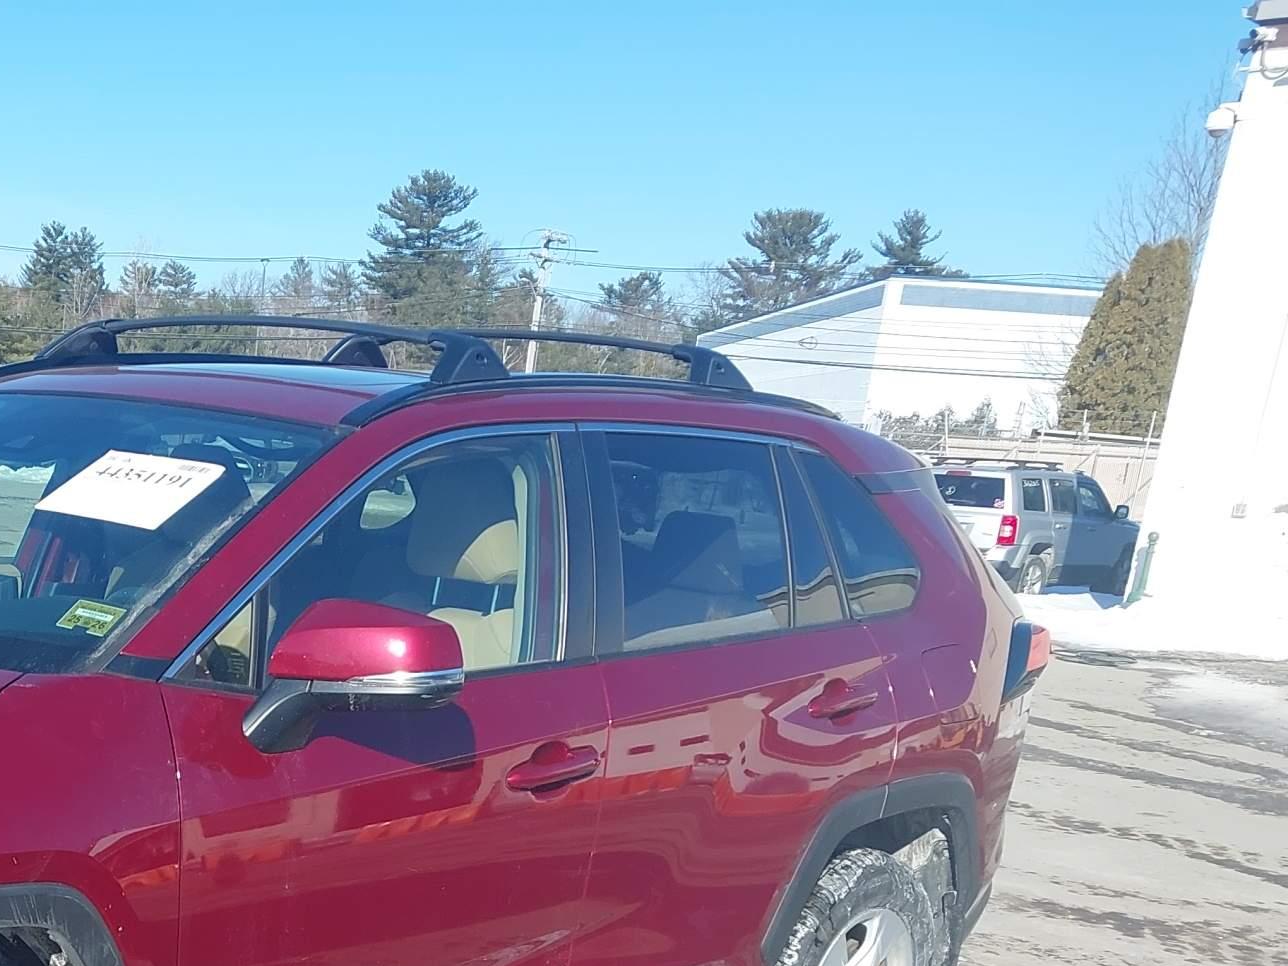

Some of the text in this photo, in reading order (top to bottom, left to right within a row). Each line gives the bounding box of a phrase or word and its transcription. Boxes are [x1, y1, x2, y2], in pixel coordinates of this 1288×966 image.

[96, 465, 193, 488] 44351191
[67, 614, 82, 624] 25
[91, 620, 107, 630] 26
